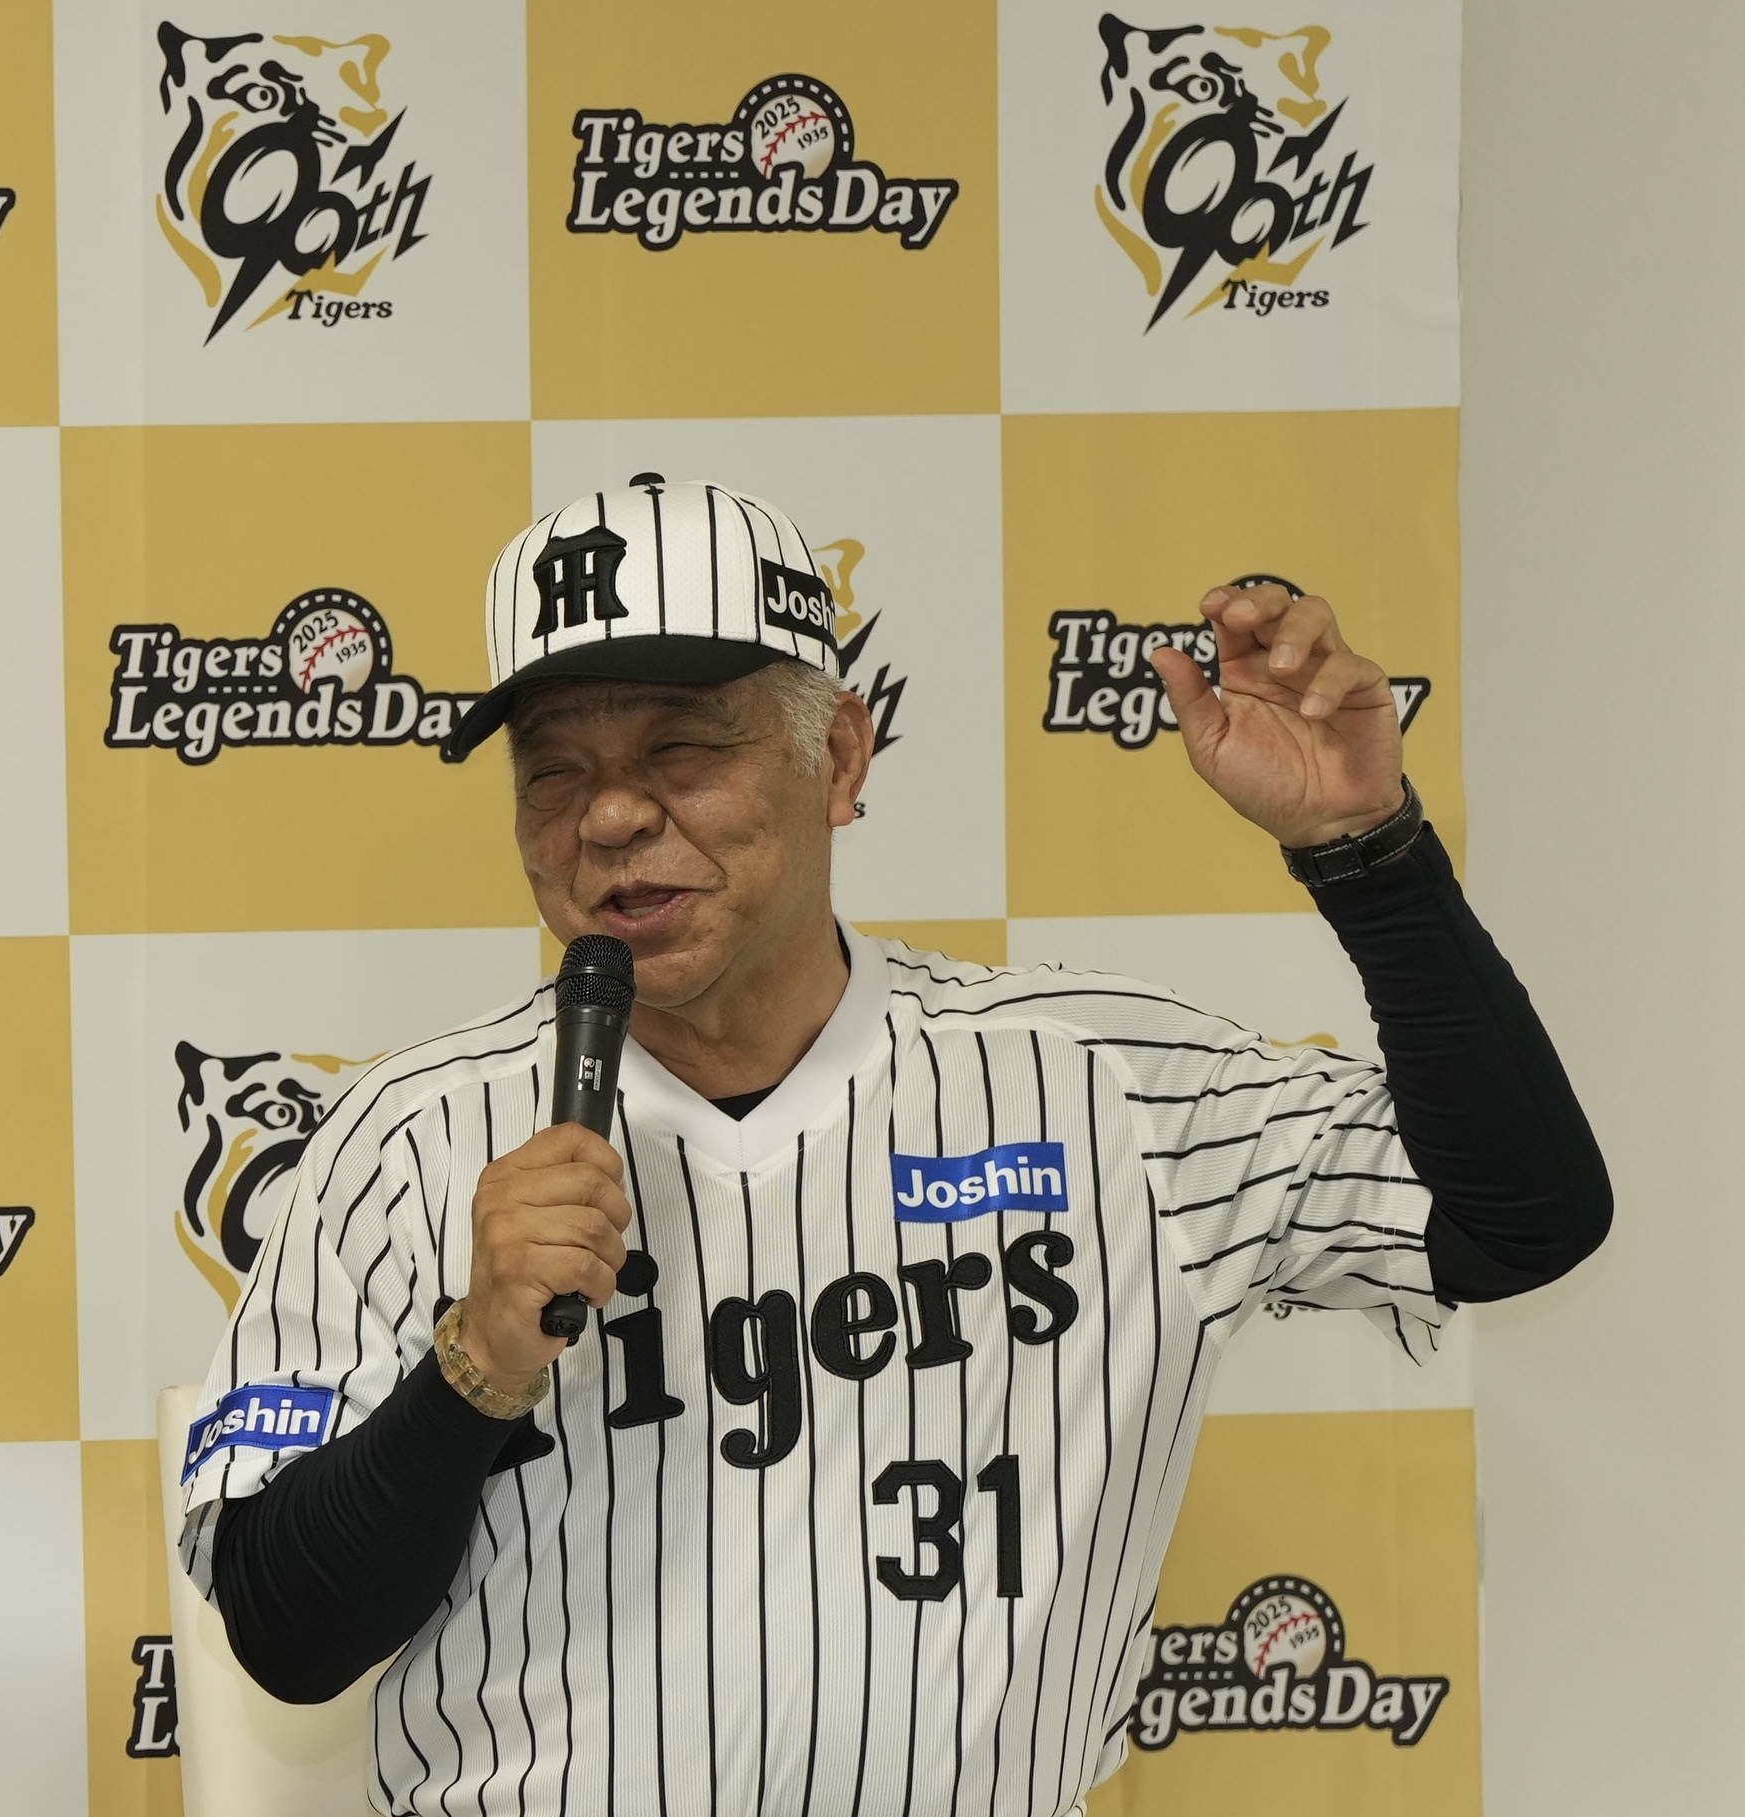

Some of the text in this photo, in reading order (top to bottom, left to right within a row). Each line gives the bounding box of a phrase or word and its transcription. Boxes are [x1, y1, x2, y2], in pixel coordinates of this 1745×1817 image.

[754, 96, 802, 140] 2025
[795, 125, 830, 150] 1935
[577, 117, 746, 178] Tigers
[283, 288, 395, 327] Tigers
[1219, 277, 1329, 317] Tigers
[767, 574, 836, 638] Joshi
[293, 610, 340, 654] 2025
[334, 639, 368, 664] 1935
[116, 631, 284, 693] Tigers
[897, 1156, 1062, 1208] Joshin
[520, 1230, 1078, 1469] igers
[189, 1397, 321, 1465] Joshin
[872, 1455, 1023, 1602] 31
[1247, 1597, 1293, 1640] 2025
[1287, 1625, 1321, 1650] 1935
